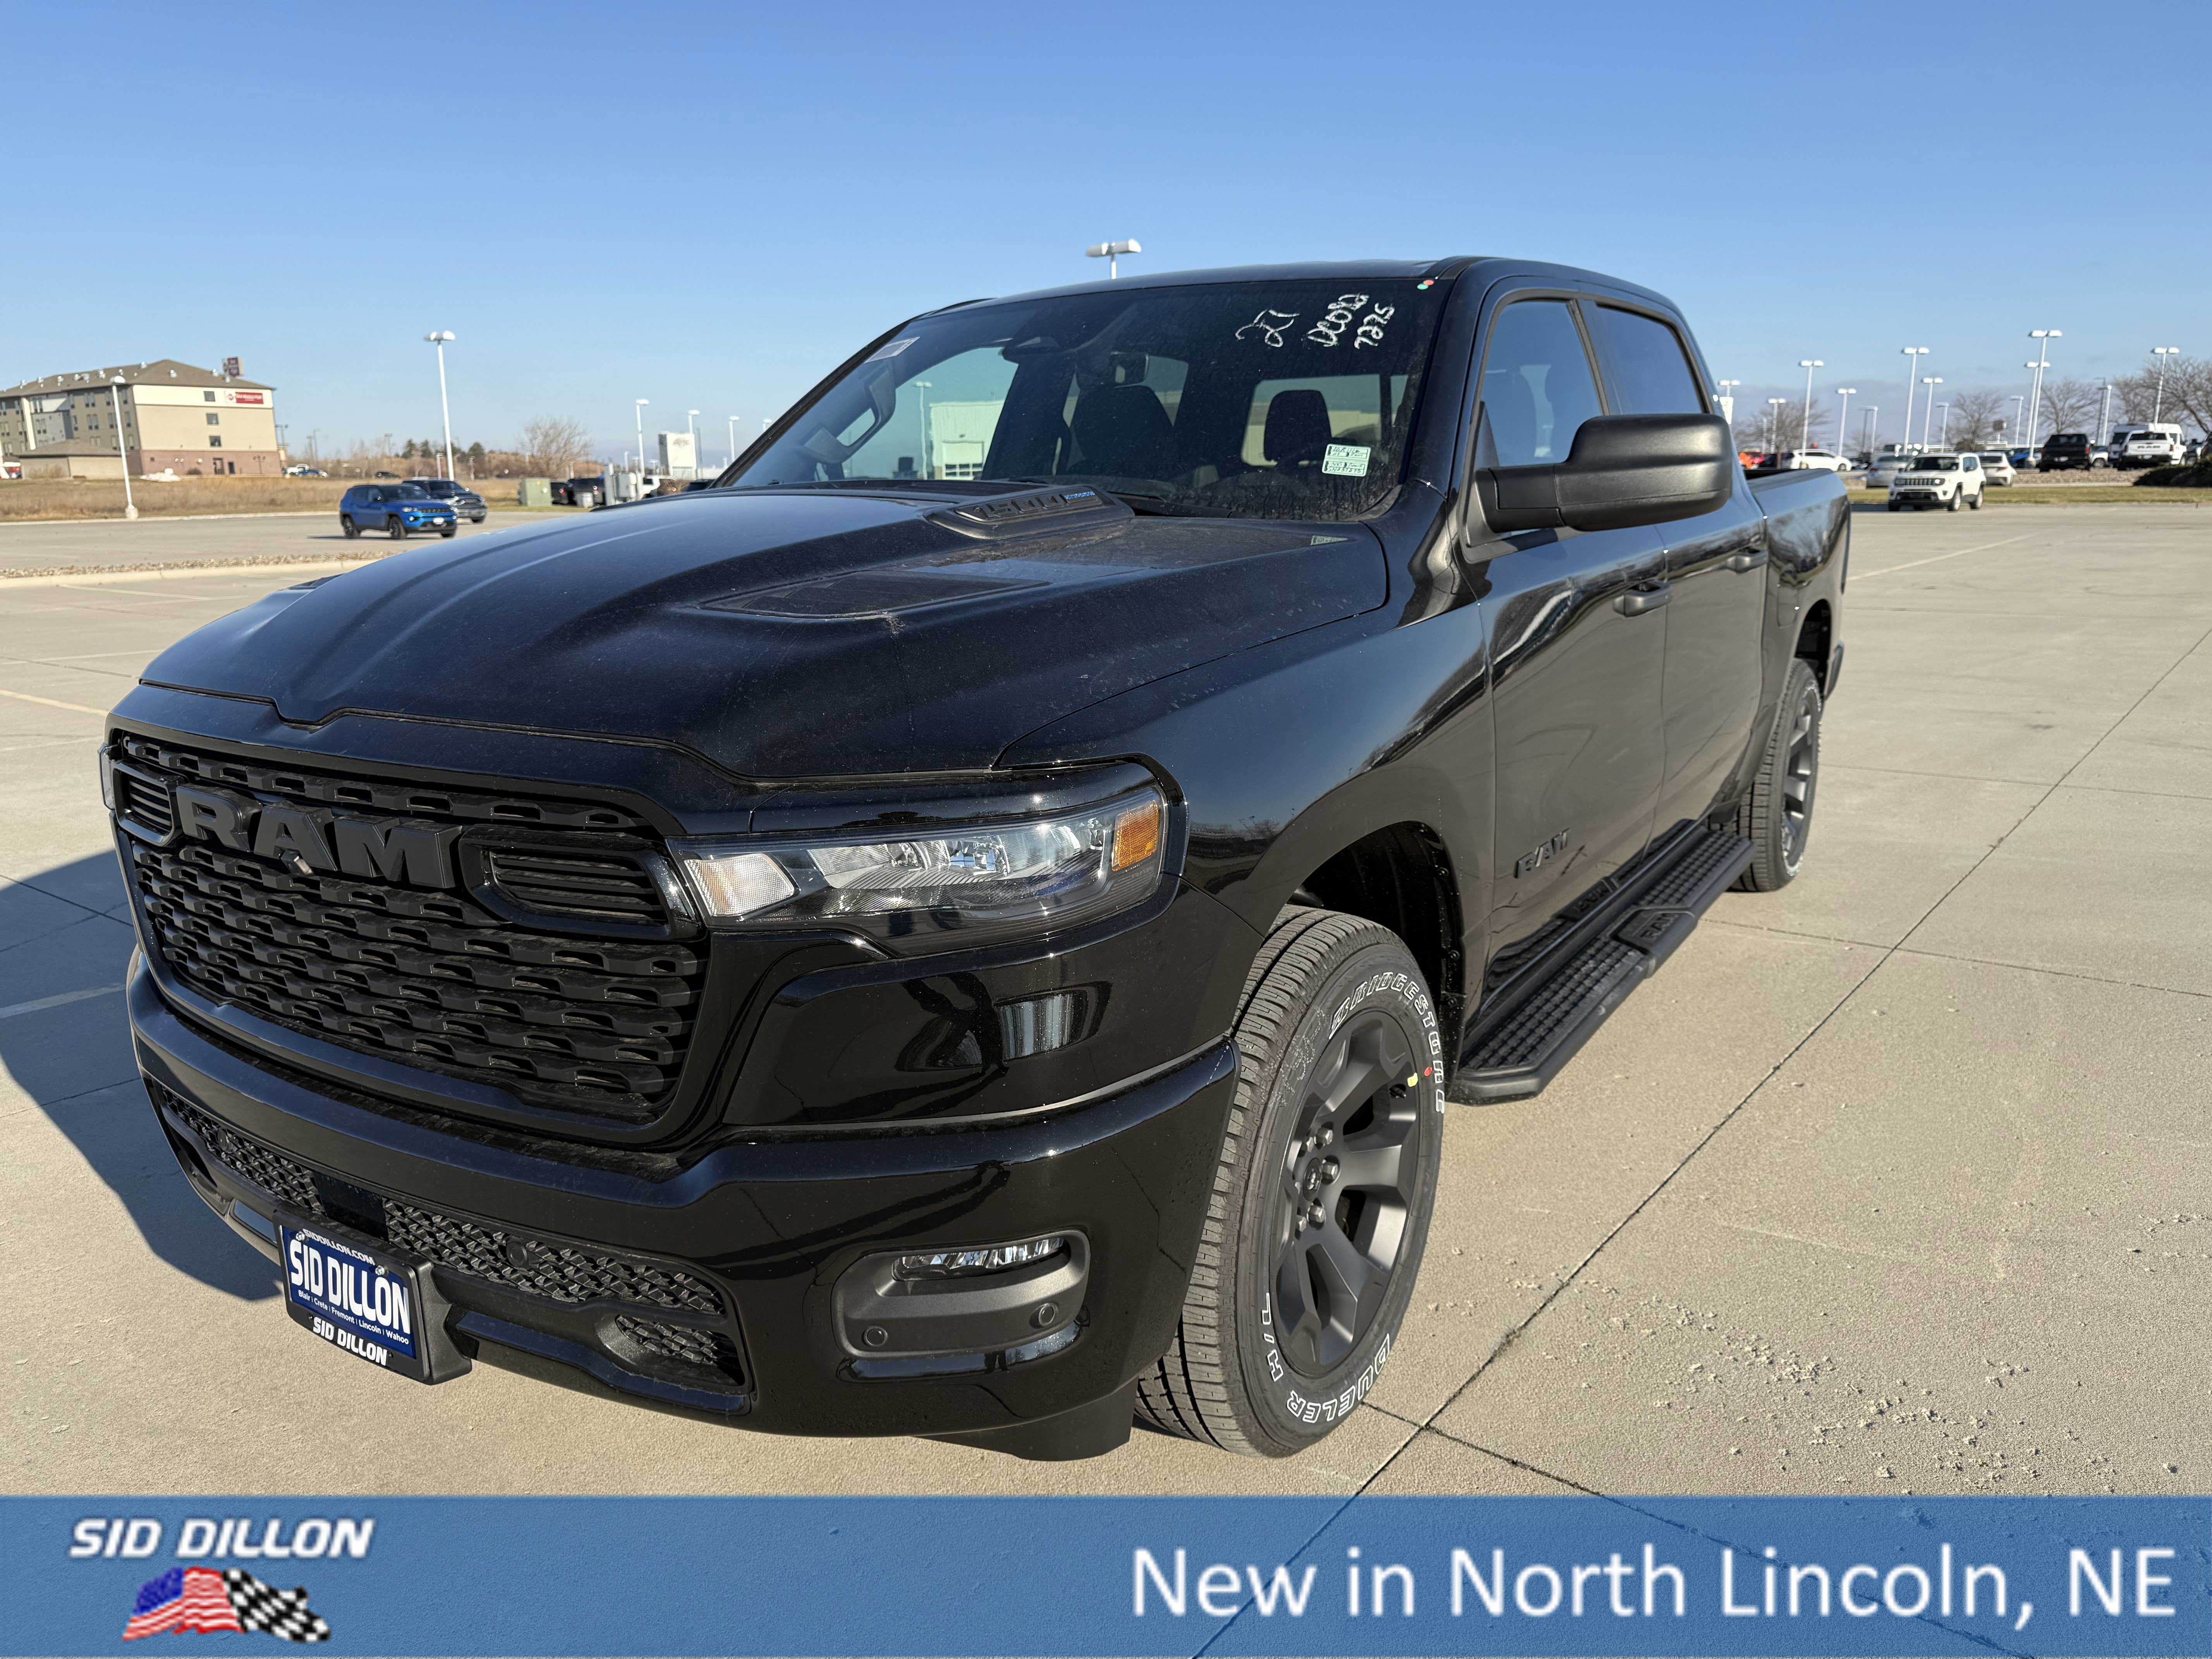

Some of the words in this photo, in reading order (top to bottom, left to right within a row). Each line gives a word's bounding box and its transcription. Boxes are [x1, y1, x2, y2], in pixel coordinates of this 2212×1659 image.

[974, 495, 1064, 519] 1500
[176, 783, 463, 889] RAM
[1513, 828, 1570, 878] RAM
[1640, 914, 1680, 941] RAM
[1329, 972, 1445, 1114] BRIDGESTONE
[302, 1228, 376, 1266] SIDDILLON.COM
[290, 1239, 323, 1297] SID
[328, 1256, 410, 1334] DILLON
[298, 1290, 310, 1301] Blair
[314, 1298, 328, 1311] Crete
[331, 1307, 355, 1324] Fremont
[359, 1320, 381, 1334] Lincoln
[385, 1329, 409, 1345] Wahoo
[313, 1317, 334, 1341] SID
[337, 1328, 387, 1366] DILLON
[1287, 1333, 1390, 1424] DUELER
